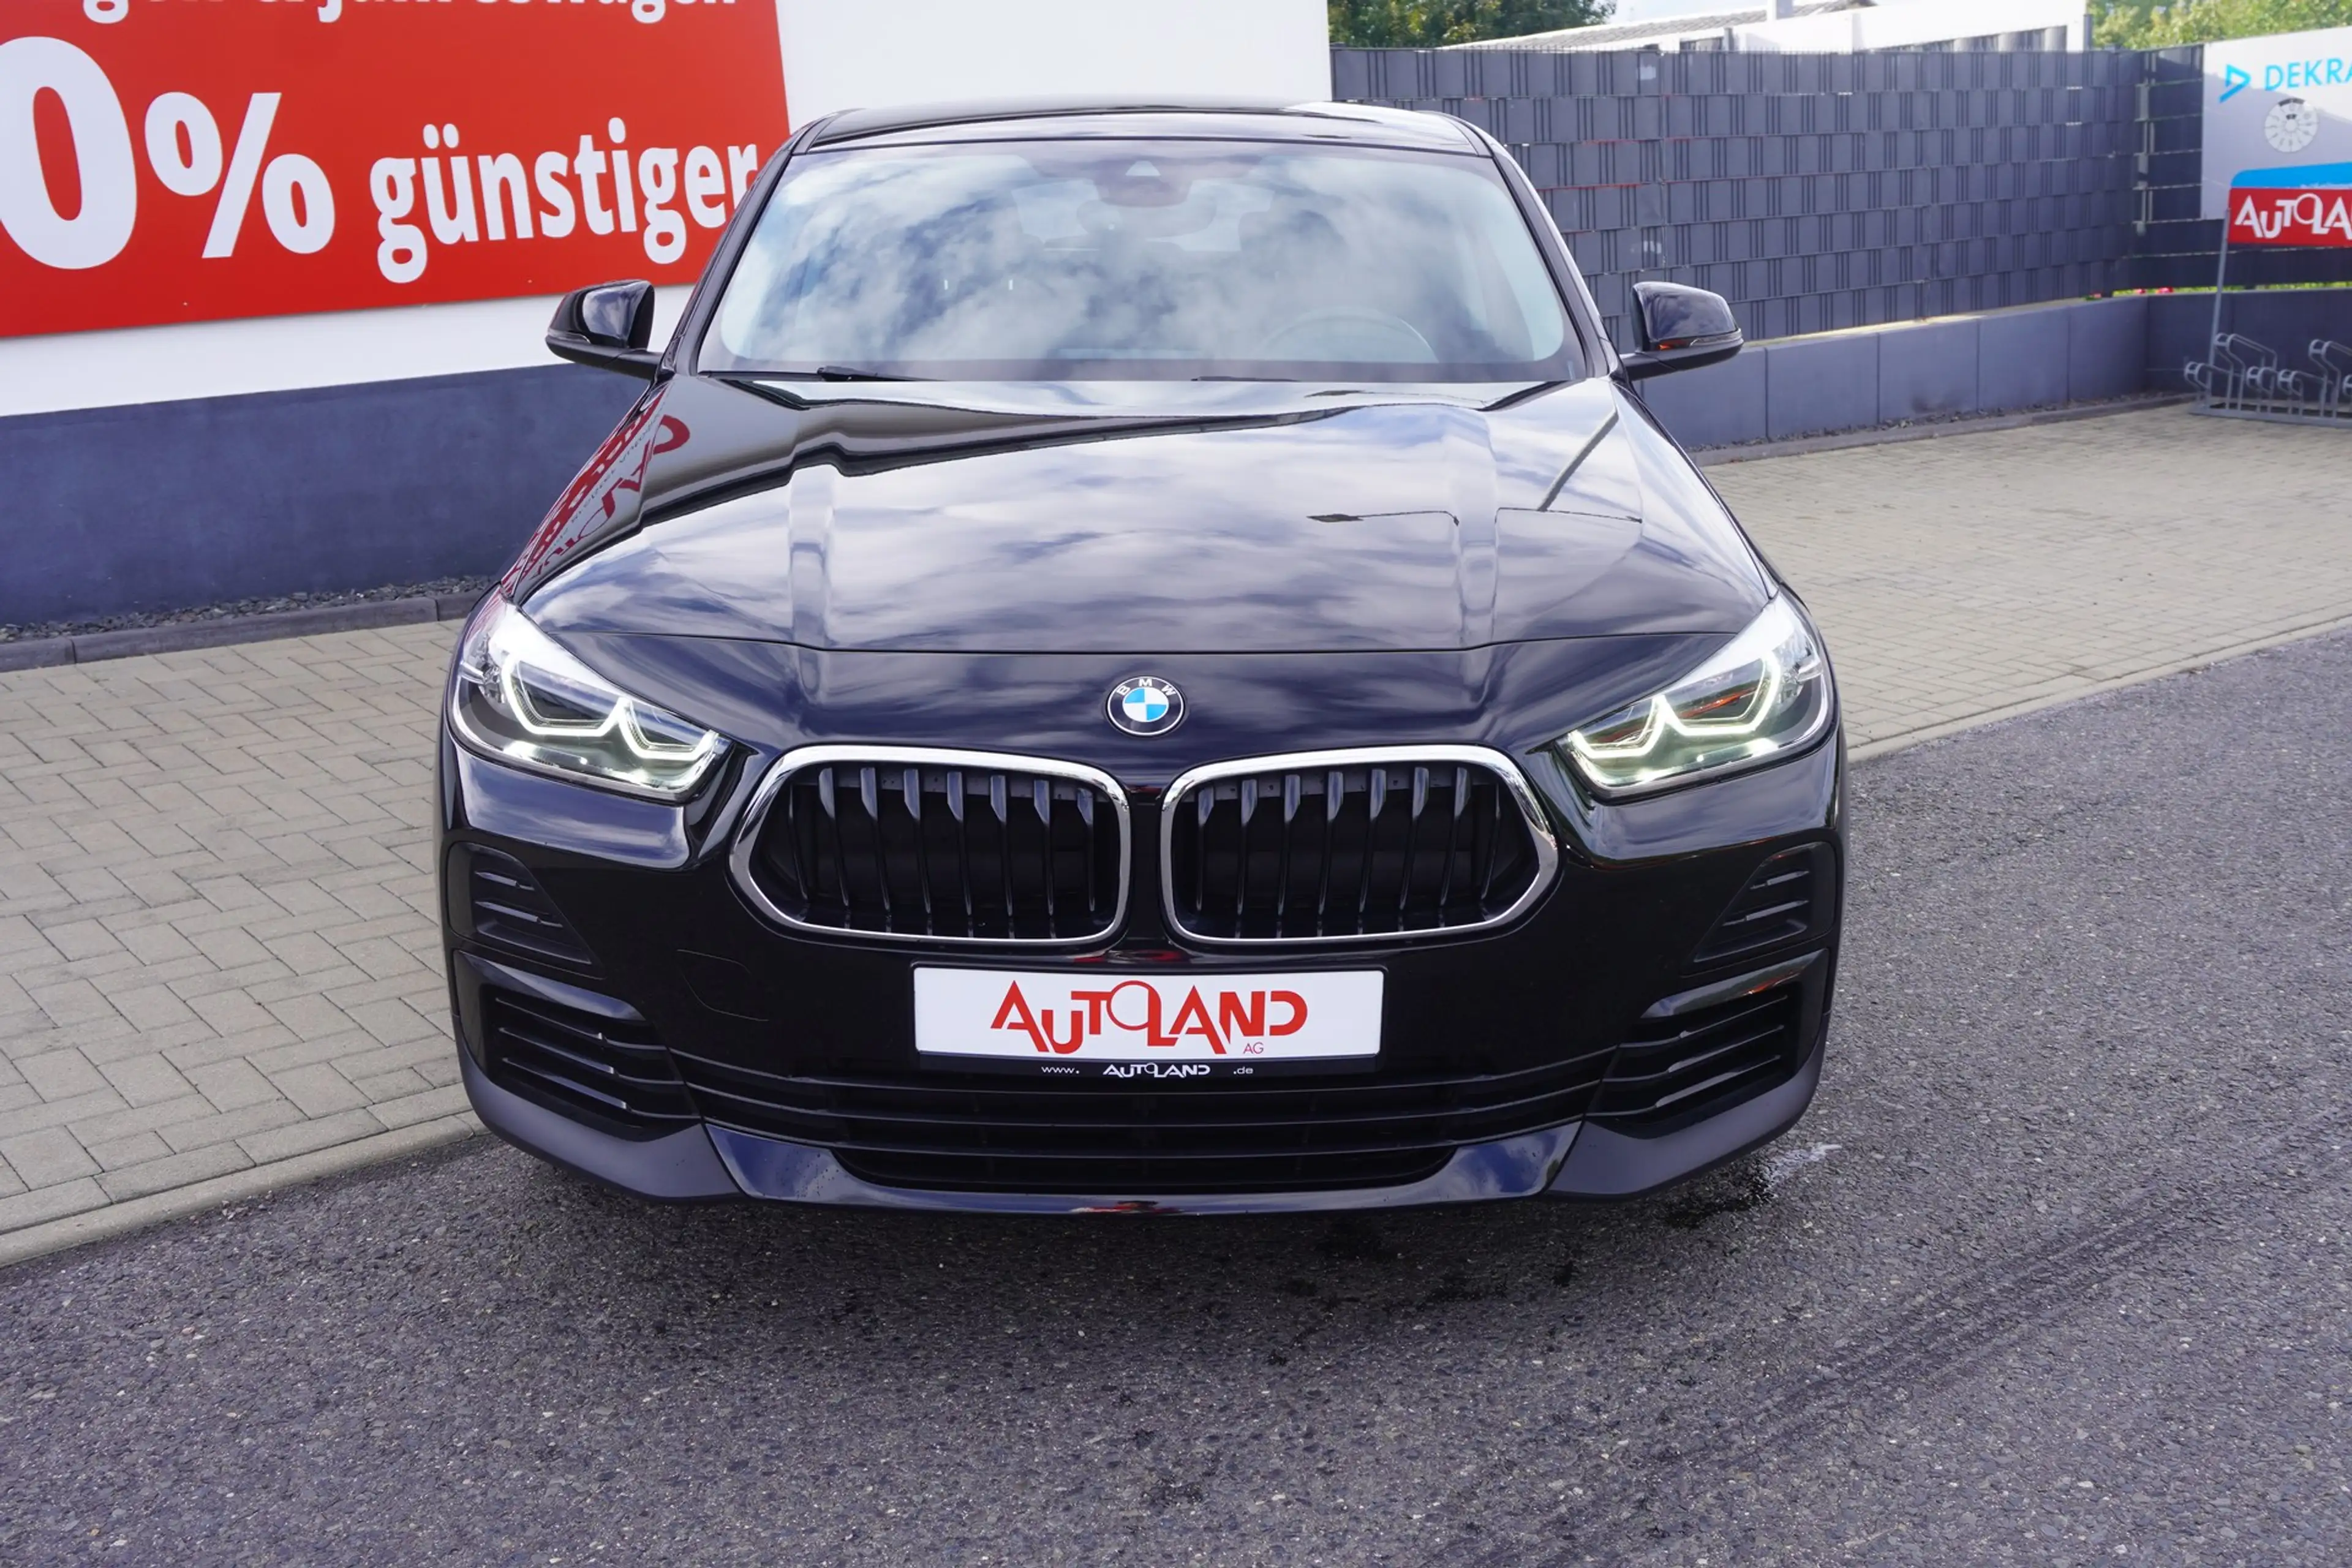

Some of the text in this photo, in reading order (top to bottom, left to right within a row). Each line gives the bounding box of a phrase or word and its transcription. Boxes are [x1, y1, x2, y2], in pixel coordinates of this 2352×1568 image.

[0, 36, 758, 283] 0% günstiger
[1116, 678, 1176, 696] BMW
[991, 981, 1308, 1054] AUTOLAND
[1243, 1042, 1264, 1054] AG
[1102, 1062, 1211, 1078] AUTOLAND
[1233, 1066, 1254, 1074] .de
